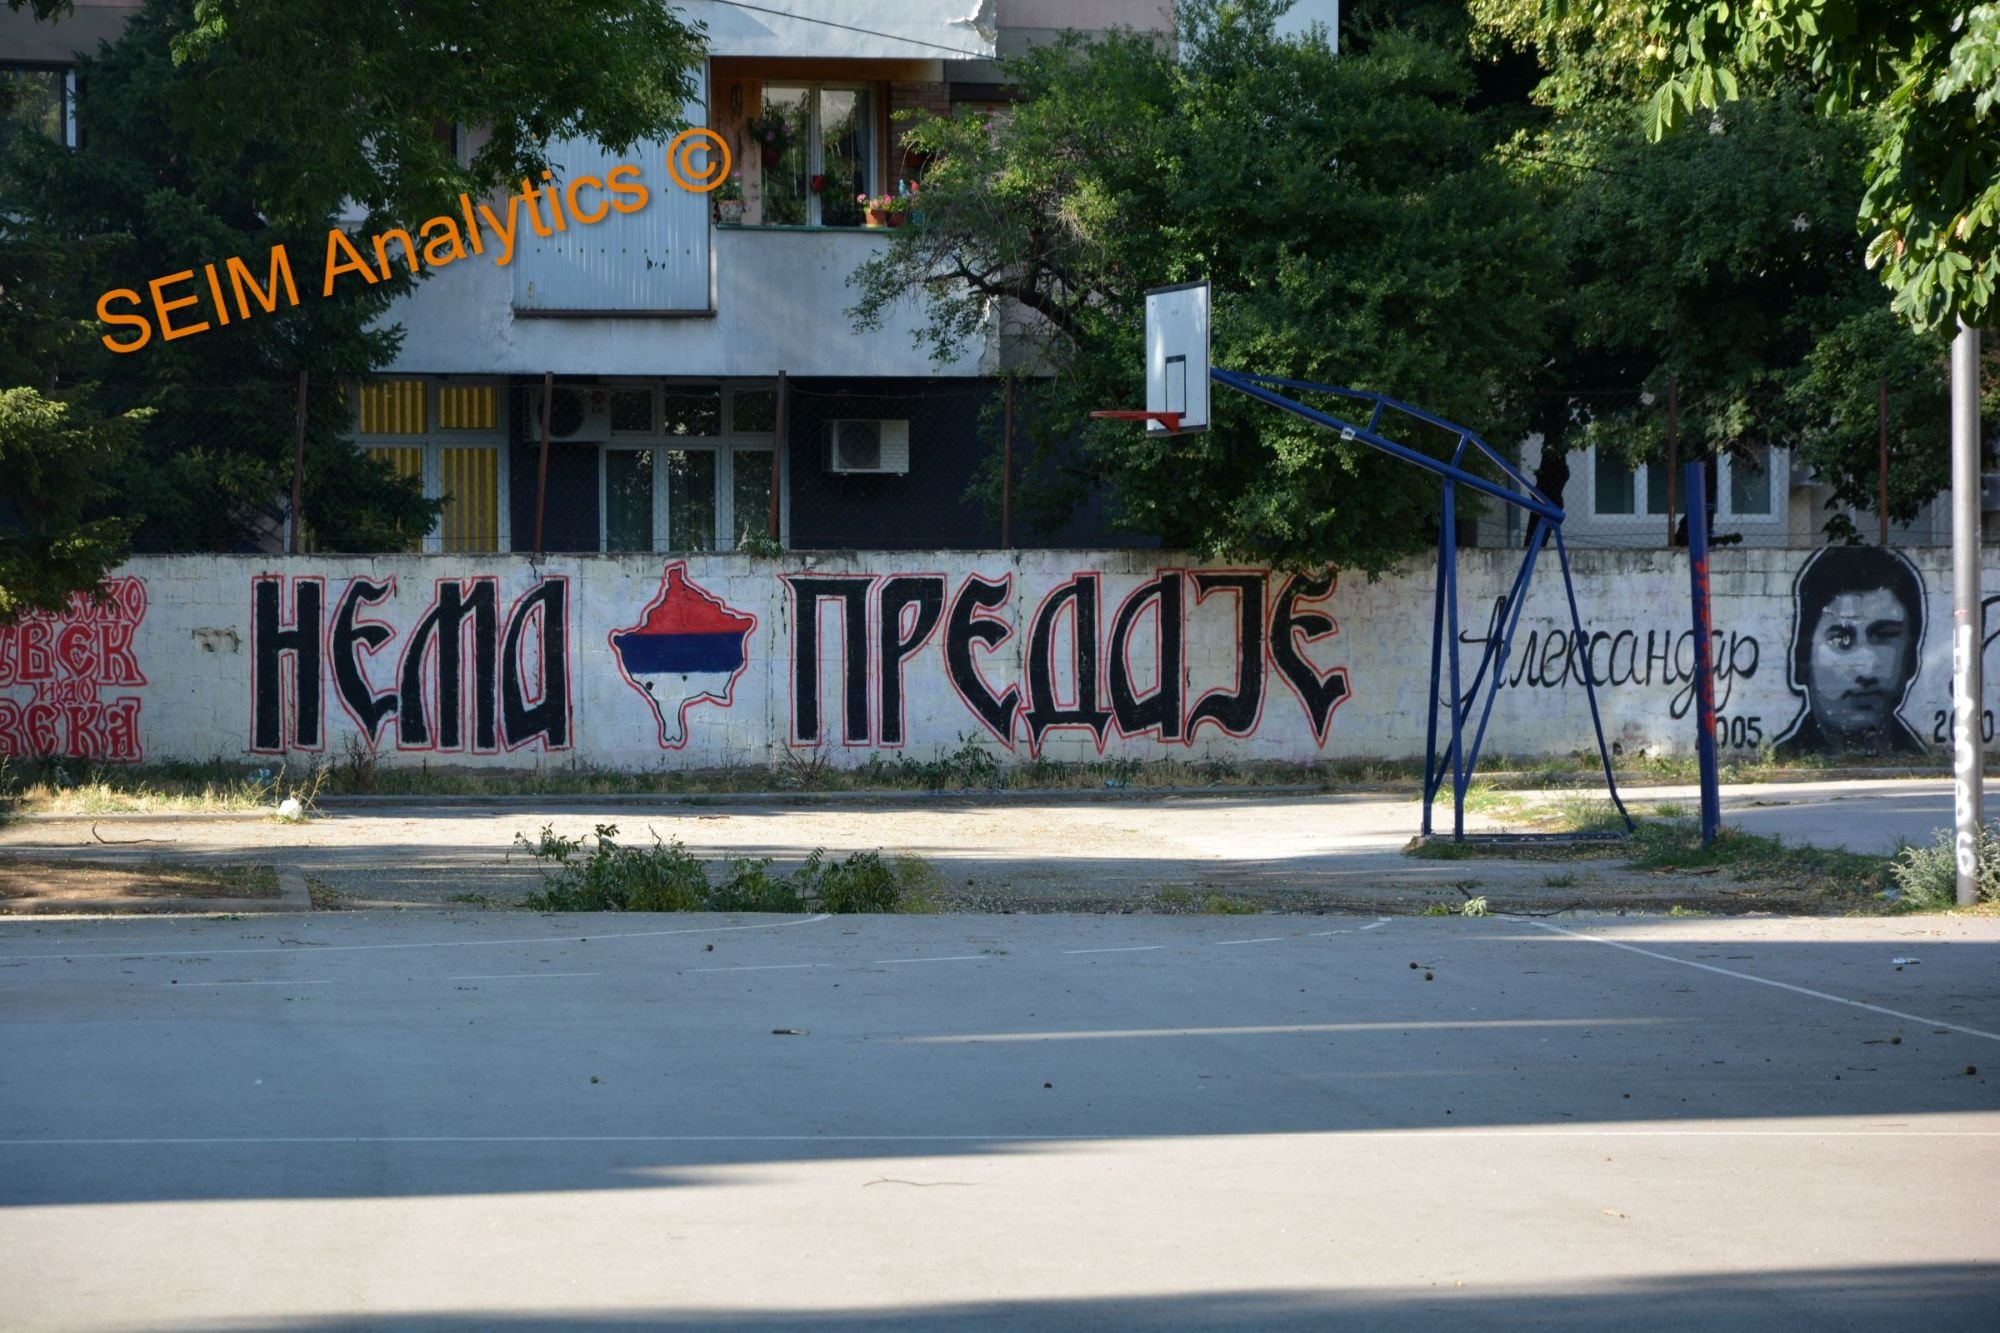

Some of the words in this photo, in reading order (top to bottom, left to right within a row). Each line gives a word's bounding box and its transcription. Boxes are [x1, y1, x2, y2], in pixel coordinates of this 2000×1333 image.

[251, 574, 573, 756] НЕМА
[778, 568, 1351, 758] ПРЕДАЈЕ
[1695, 714, 1763, 750] 005
